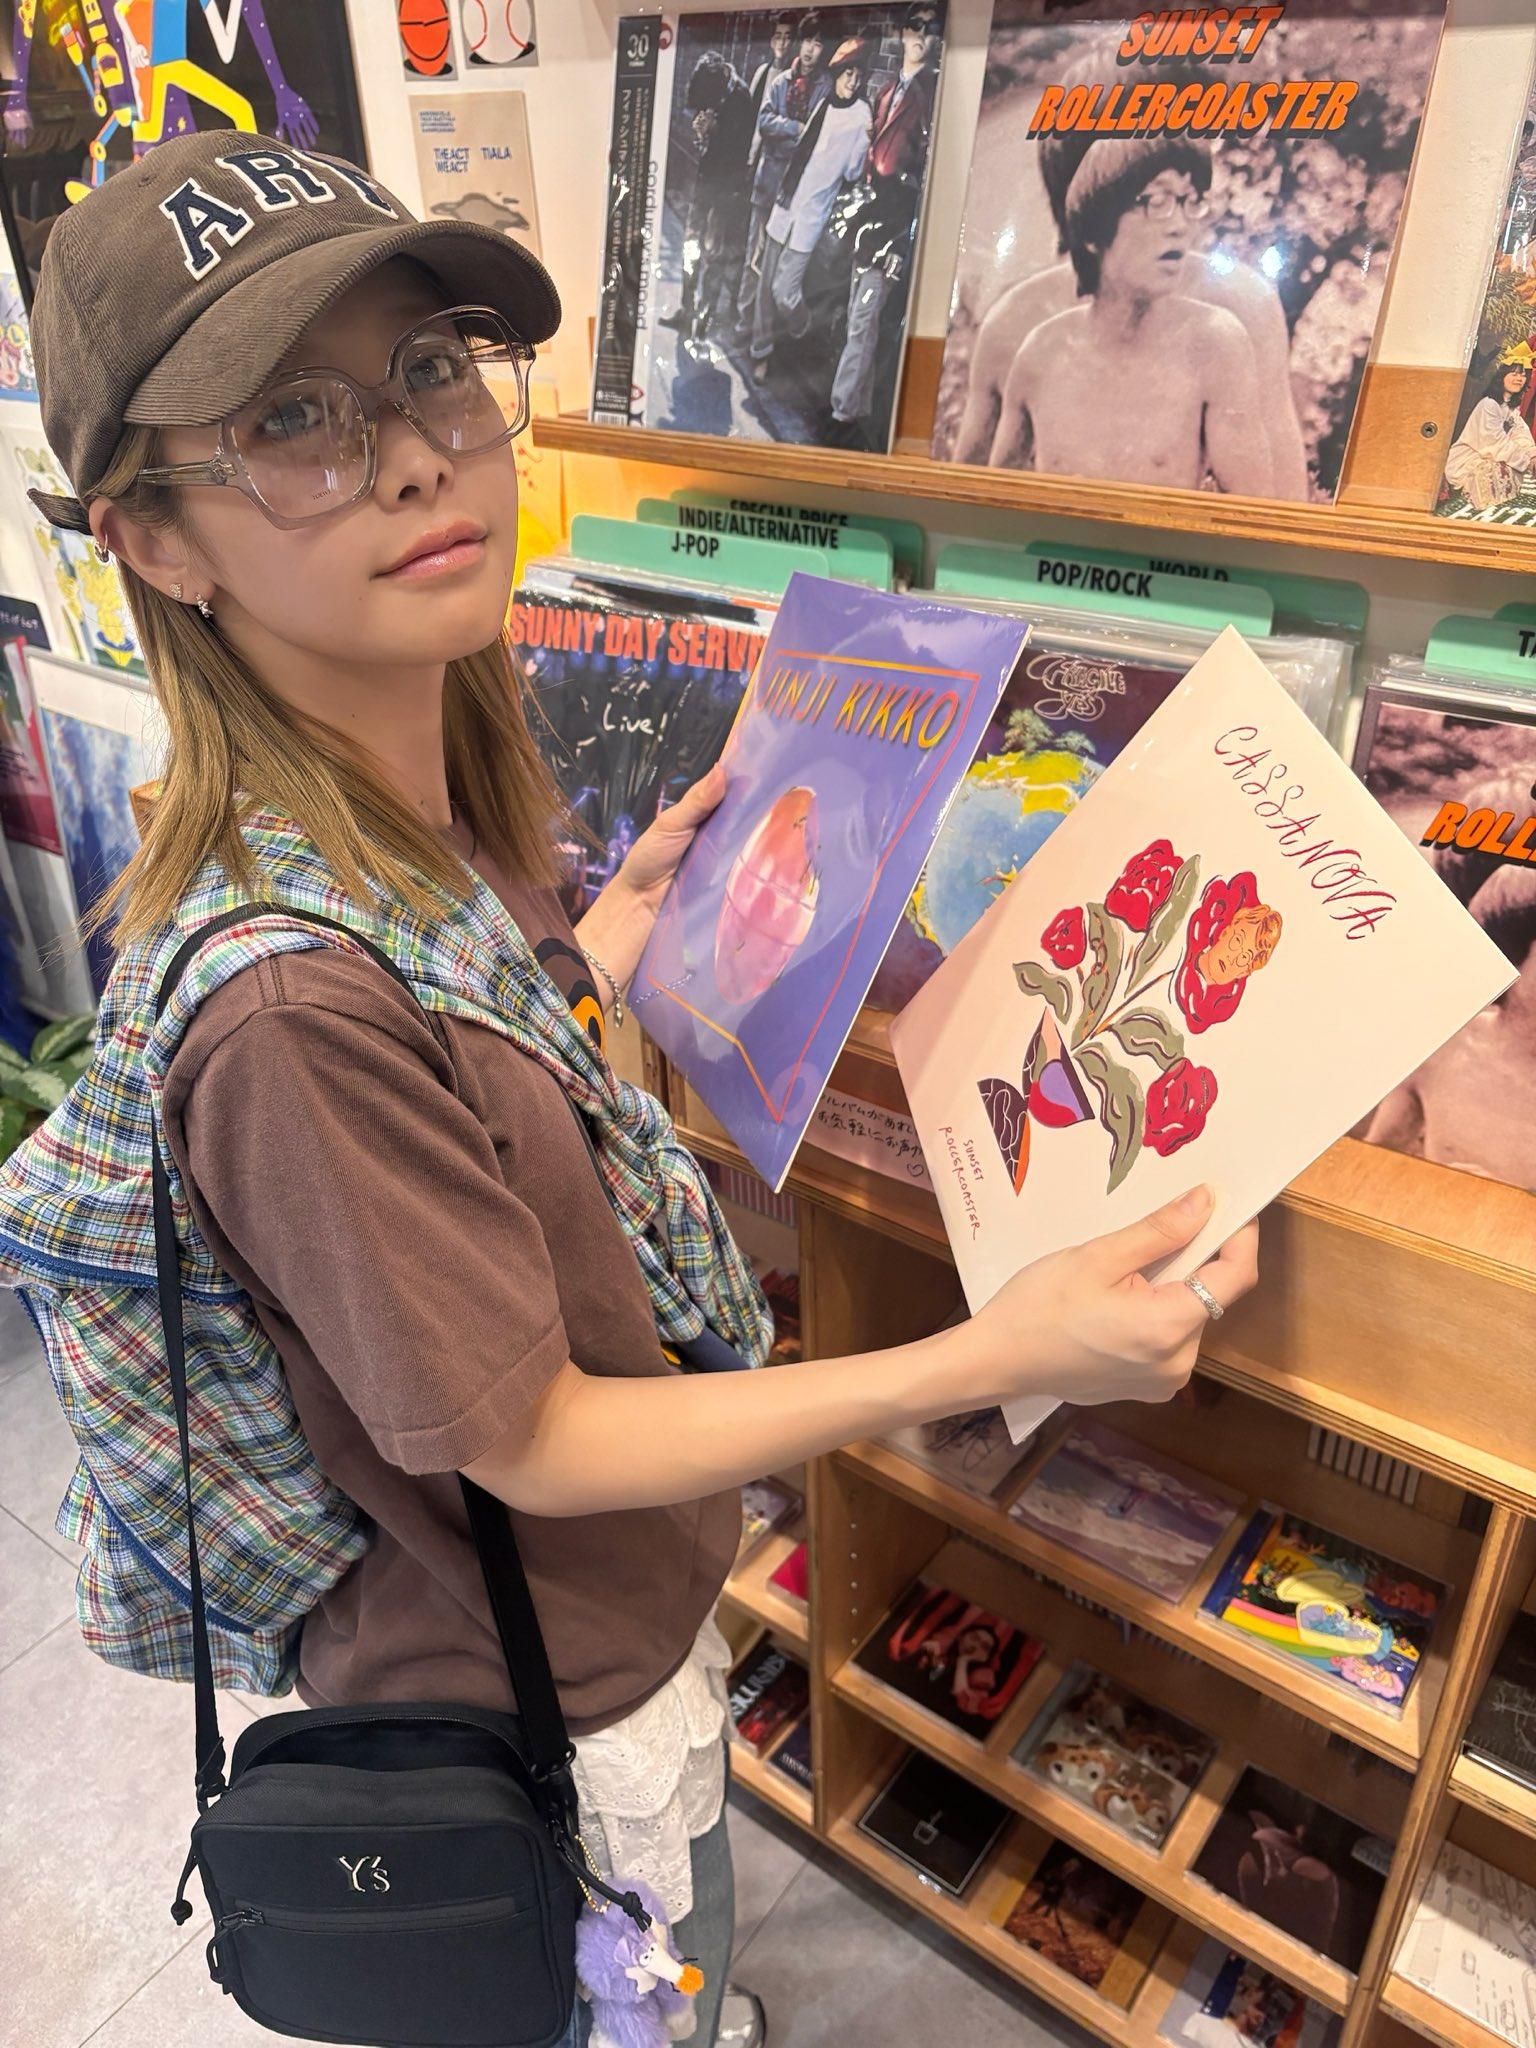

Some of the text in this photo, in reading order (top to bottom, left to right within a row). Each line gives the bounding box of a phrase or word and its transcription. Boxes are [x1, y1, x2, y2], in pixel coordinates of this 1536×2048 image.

[1118, 6, 1285, 62] SUNSET
[1028, 81, 1360, 136] ROLLERCOASTER
[616, 88, 632, 187] フィッシュマン
[636, 270, 650, 330] mood
[671, 531, 719, 558] J-POP
[679, 505, 838, 549] INDIE/ALTERNATIVE
[1037, 559, 1152, 598] POP/ROCK
[511, 602, 605, 654] SUNNY
[604, 613, 665, 661] DAY
[603, 703, 668, 742] Live!
[757, 667, 960, 749] JINJI KIKKO
[1214, 726, 1397, 940] CASSANOVA
[963, 1139, 984, 1182] SUNSET
[337, 1855, 390, 1893] Y's
